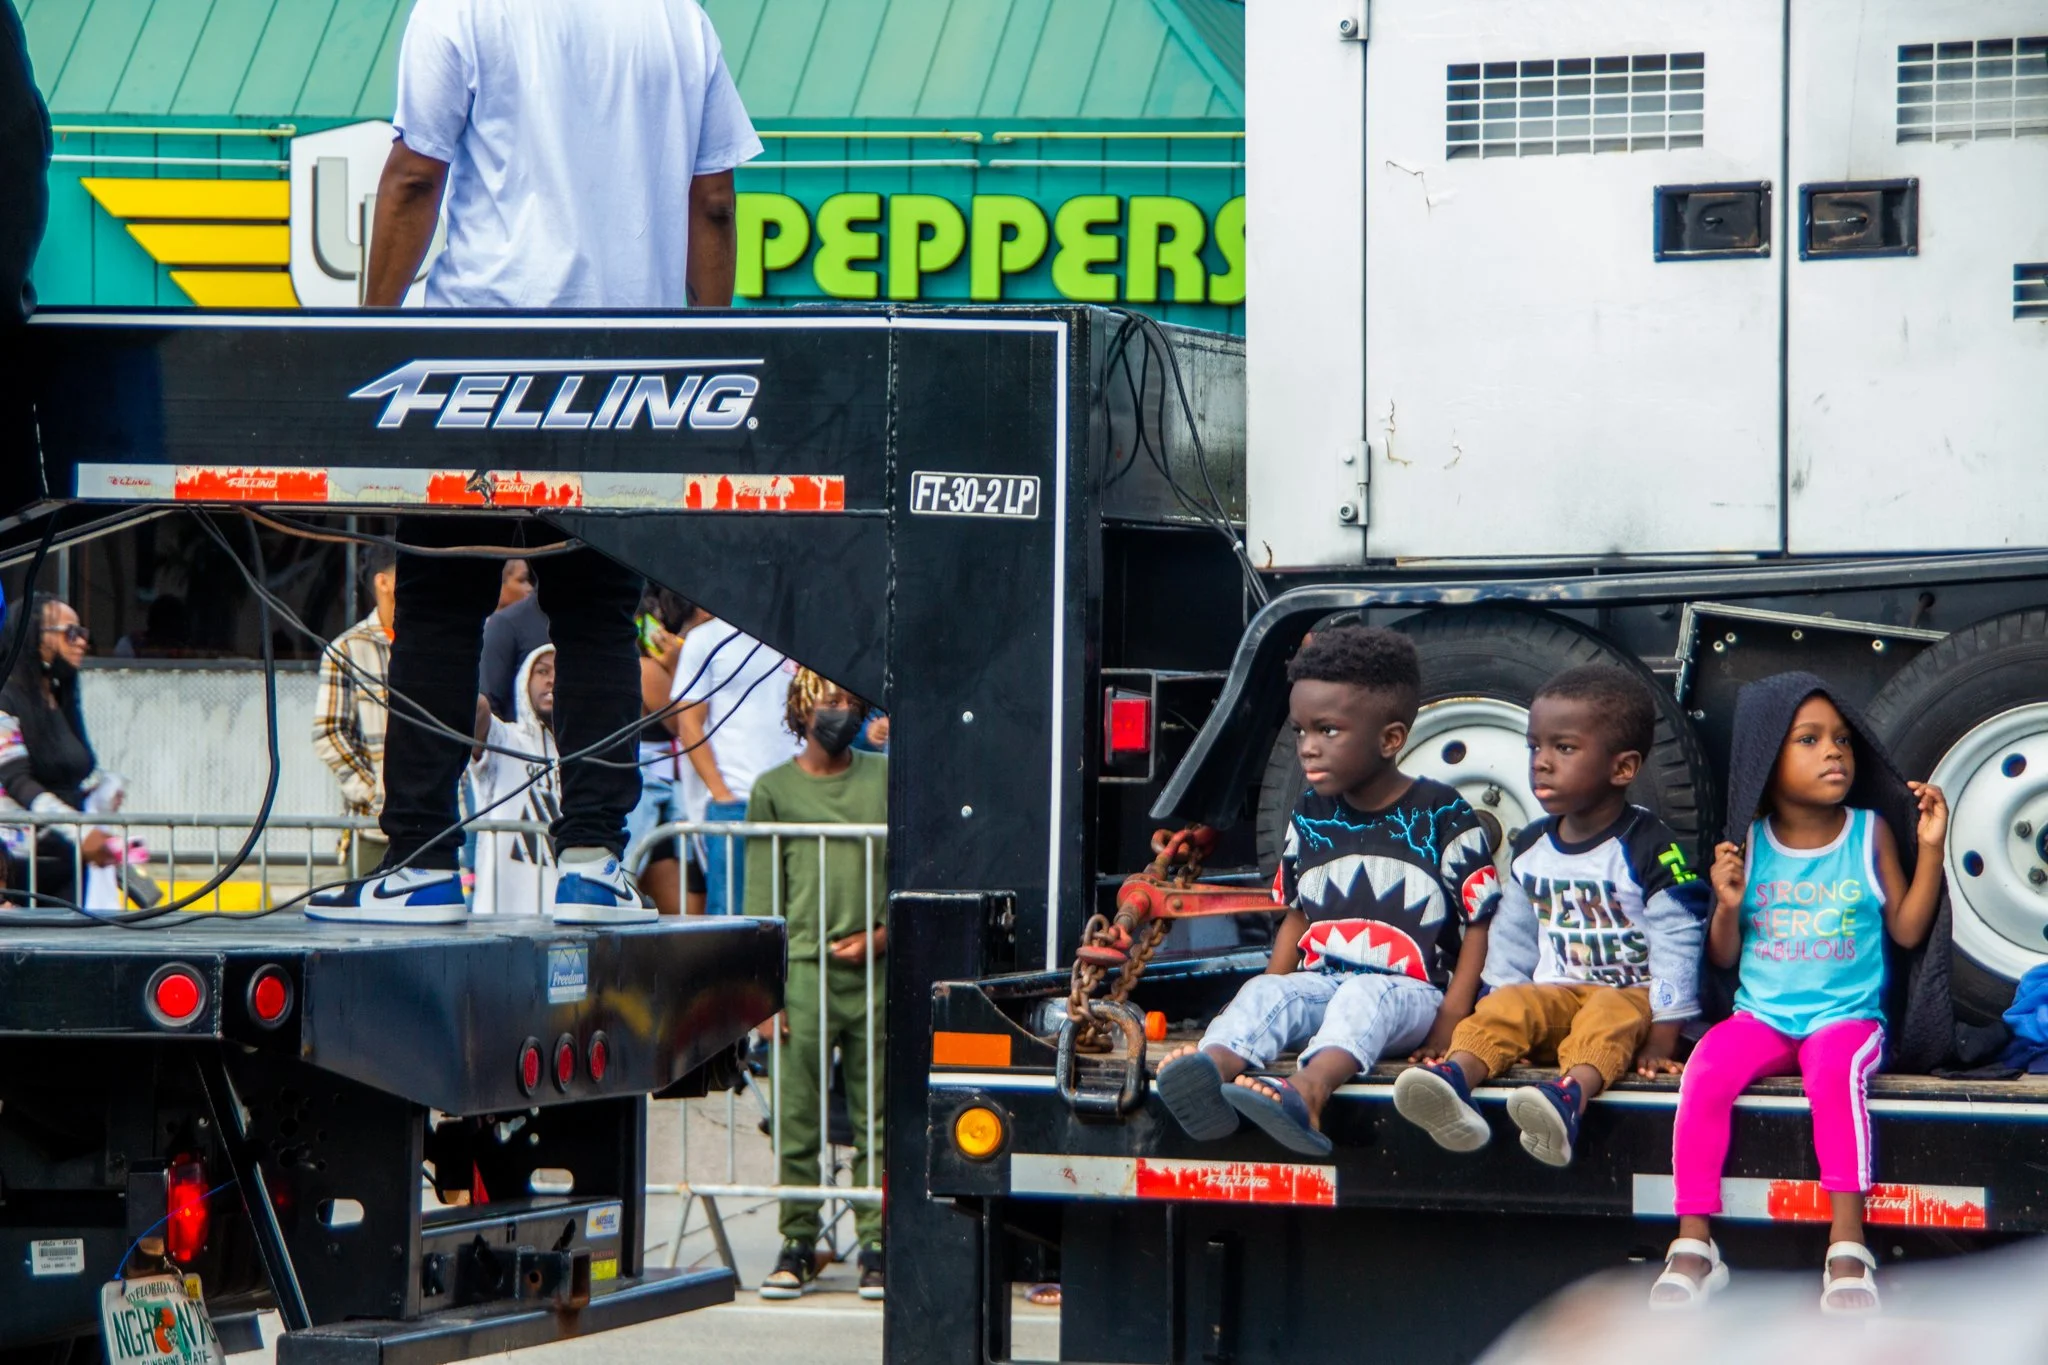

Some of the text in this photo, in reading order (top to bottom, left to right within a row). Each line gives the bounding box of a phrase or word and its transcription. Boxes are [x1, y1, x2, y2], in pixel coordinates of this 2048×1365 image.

[348, 358, 764, 429] FELLING
[226, 477, 277, 489] FELLING
[916, 475, 1035, 514] FT-30-2 LP
[1756, 879, 1862, 907] STRONG
[1754, 939, 1856, 961] FABULOUS
[1198, 1173, 1271, 1188] FELLING
